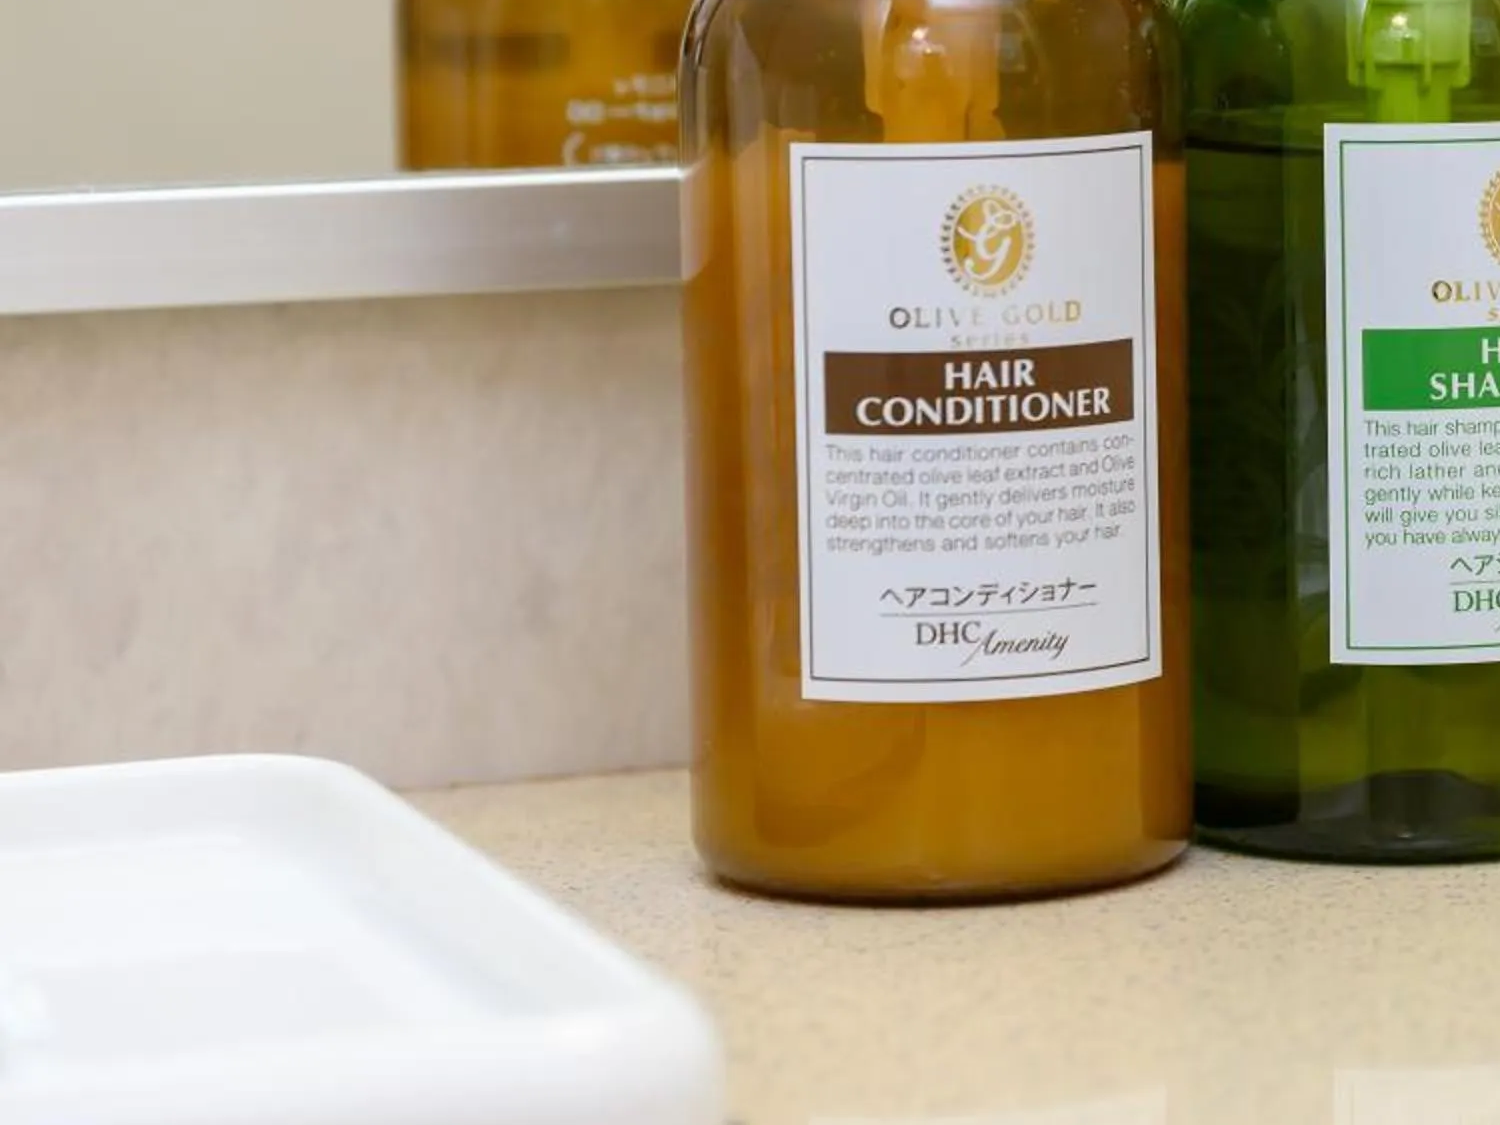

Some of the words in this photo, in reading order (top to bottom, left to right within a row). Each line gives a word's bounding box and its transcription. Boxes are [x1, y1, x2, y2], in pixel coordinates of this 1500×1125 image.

[889, 307, 983, 328] OLIVE
[1003, 301, 1082, 326] GOLD
[945, 359, 1035, 390] HAIR
[856, 387, 1110, 426] CONDITIONER
[1365, 420, 1400, 436] This
[1407, 421, 1438, 436] hair
[1365, 442, 1421, 458] trated
[1429, 440, 1471, 457] olive
[1365, 464, 1400, 480] rich
[1409, 462, 1465, 479] lather
[1365, 487, 1421, 506] gently
[1428, 483, 1475, 501] while
[1366, 508, 1393, 523] will
[1400, 508, 1438, 526] give
[1445, 508, 1478, 525] you
[1366, 533, 1396, 549] you
[1403, 527, 1445, 545] have
[879, 577, 1097, 607] ヘアコンディショナー
[916, 621, 981, 646] DHC
[961, 629, 1070, 667] Amenity
